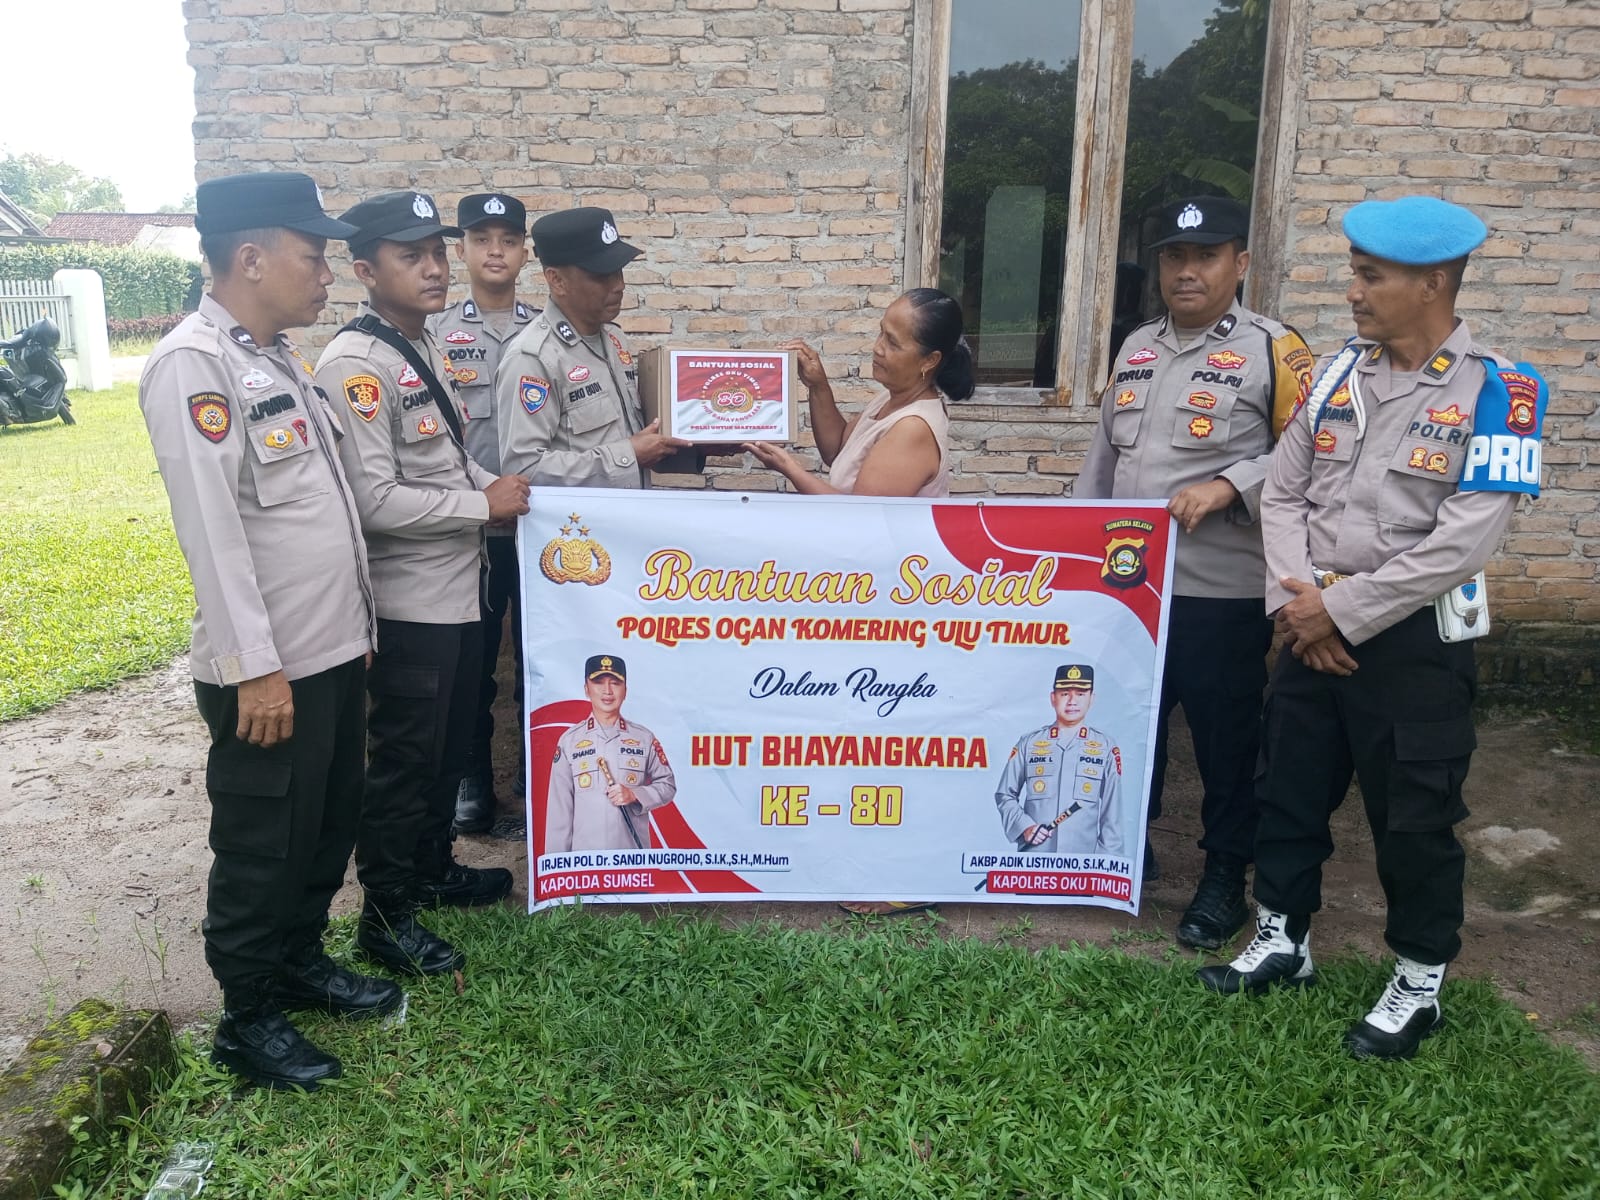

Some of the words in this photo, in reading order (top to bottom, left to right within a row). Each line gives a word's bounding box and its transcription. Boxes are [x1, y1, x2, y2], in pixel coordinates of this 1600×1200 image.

[1116, 369, 1153, 384] IDRUS
[1191, 370, 1244, 388] POLRI
[1502, 373, 1535, 387] POLDA
[569, 389, 586, 402] EKO
[717, 392, 746, 406] 80
[1408, 422, 1470, 446] POLRI
[1463, 434, 1542, 485] PRO
[639, 549, 877, 605] Bantuan
[890, 555, 1054, 607] Sosial
[617, 616, 710, 647] POLRES
[715, 617, 786, 646] OGAN
[791, 618, 927, 648] KOMERING
[932, 620, 982, 651] ULU
[985, 621, 1070, 646] TIMUR
[749, 667, 840, 698] Dalam
[845, 667, 938, 718] Rangka
[620, 747, 644, 755] POLRI
[691, 735, 752, 766] HUT
[761, 735, 988, 768] BHAYANGKARA
[1079, 756, 1103, 765] POLRI
[761, 785, 809, 826] KE
[850, 785, 902, 826] 80
[541, 855, 571, 872] IRJEN
[574, 855, 594, 868] POL
[596, 855, 611, 867] Dr.
[612, 854, 646, 866] SANDI
[648, 853, 703, 867] NUGROHO,
[970, 856, 998, 868] AKBP
[1000, 856, 1024, 868] ADIK
[1026, 857, 1081, 871] LISTIYONO,
[540, 874, 600, 895] KAPOLDA
[603, 872, 655, 888] SUMSEL
[993, 875, 1057, 890] KAPOLRES
[1060, 876, 1087, 891] OKU
[1090, 877, 1129, 897] TIMUR
